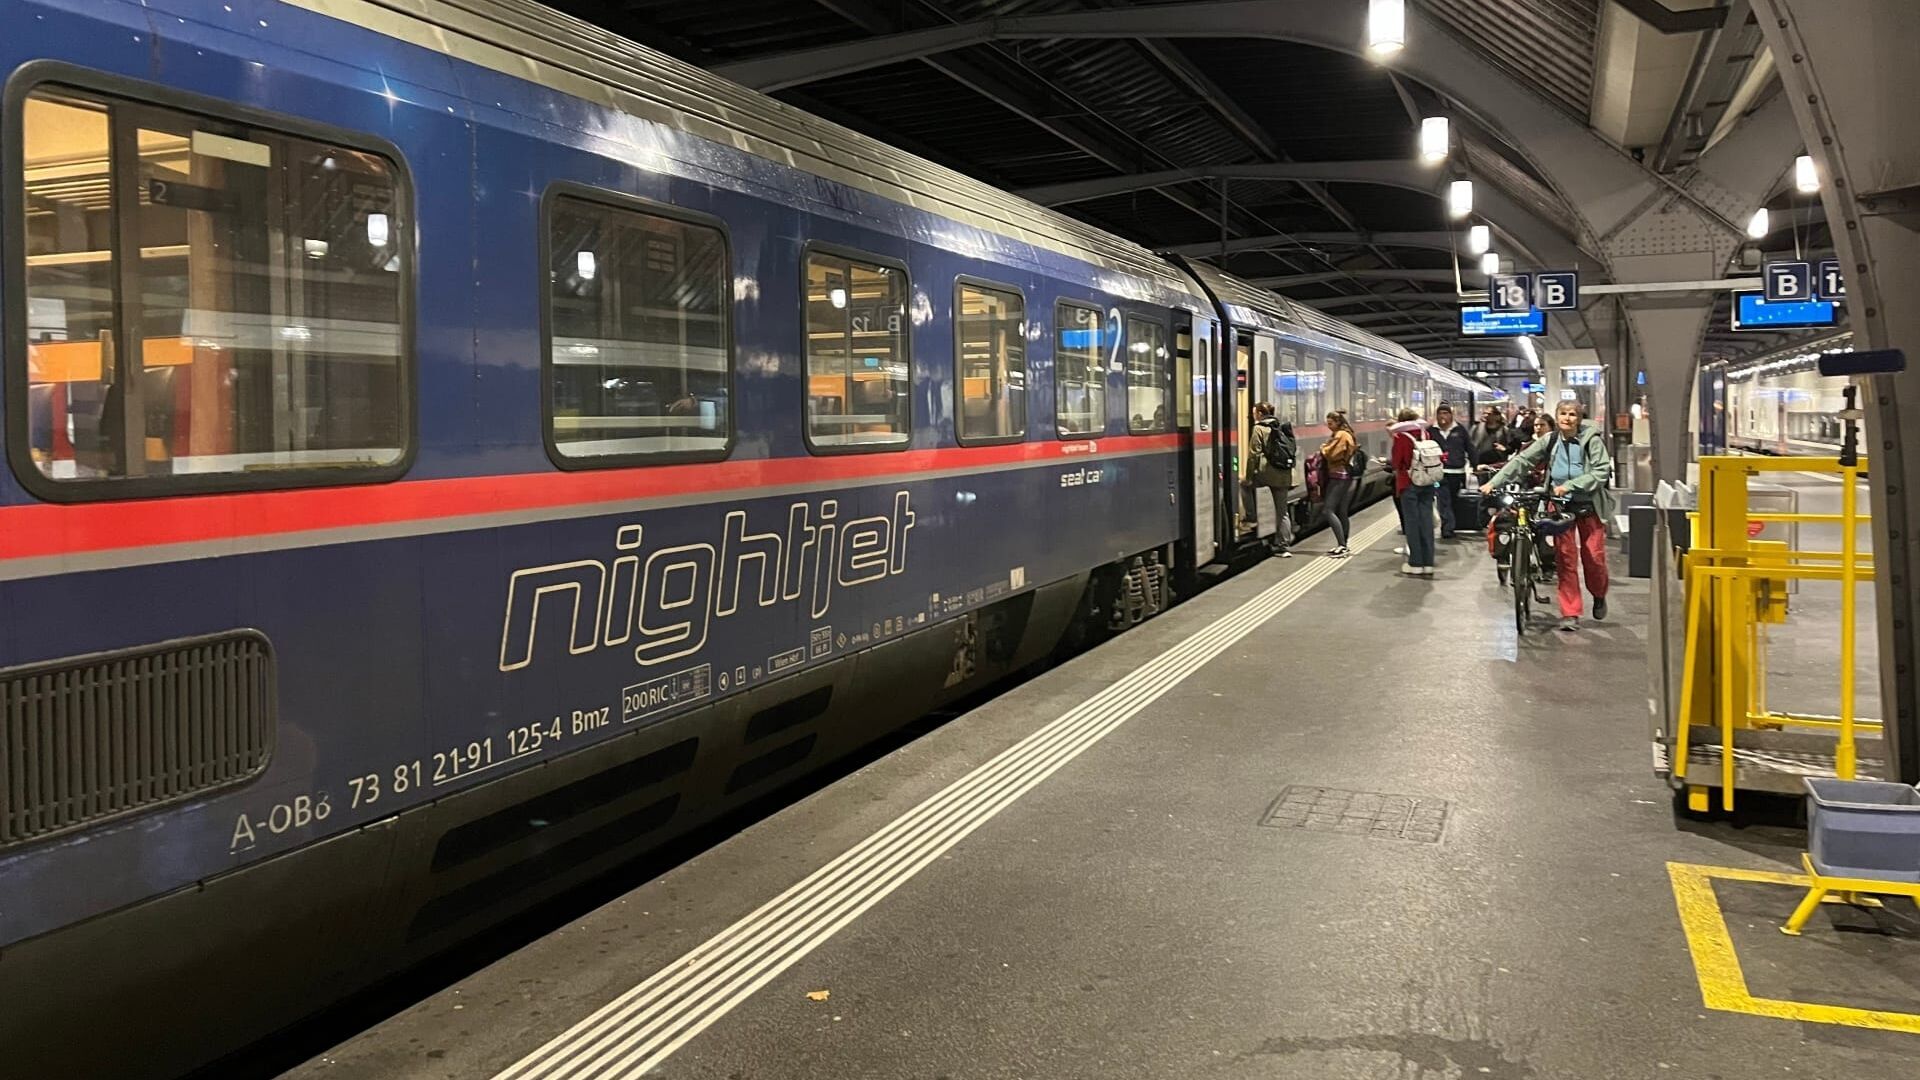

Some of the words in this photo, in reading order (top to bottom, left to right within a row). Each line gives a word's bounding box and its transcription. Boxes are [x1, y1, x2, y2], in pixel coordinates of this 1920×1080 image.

[1497, 285, 1524, 306] 13
[1547, 284, 1565, 305] B
[1778, 274, 1798, 296] B
[1109, 307, 1123, 371] 2
[499, 491, 916, 671] nightjet
[624, 691, 648, 714] 200
[649, 684, 669, 706] RIC
[348, 773, 380, 809] 73
[394, 760, 422, 793] 81
[433, 737, 492, 782] 21-91
[507, 716, 563, 756] 125-4
[572, 706, 611, 735] Bmz
